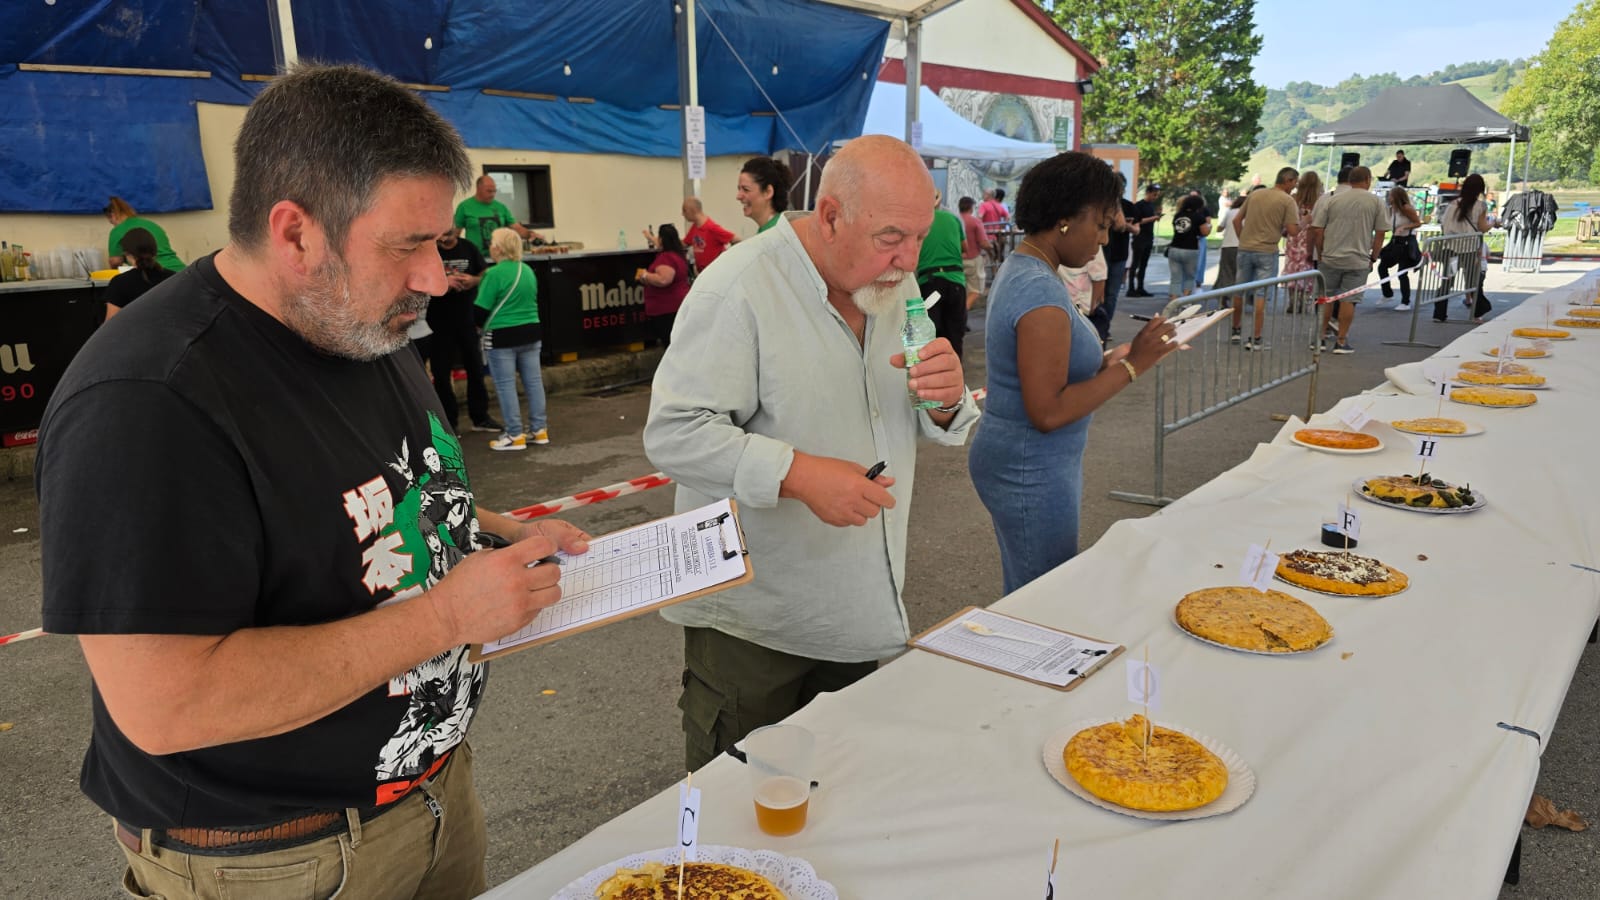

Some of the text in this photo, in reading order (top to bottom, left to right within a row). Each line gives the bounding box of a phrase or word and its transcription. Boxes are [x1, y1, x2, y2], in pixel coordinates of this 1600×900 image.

[579, 279, 645, 311] Maho
[583, 313, 625, 329] DESDE
[1439, 383, 1447, 396] I
[1418, 440, 1438, 457] H
[1343, 511, 1356, 531] F
[681, 806, 695, 847] C
